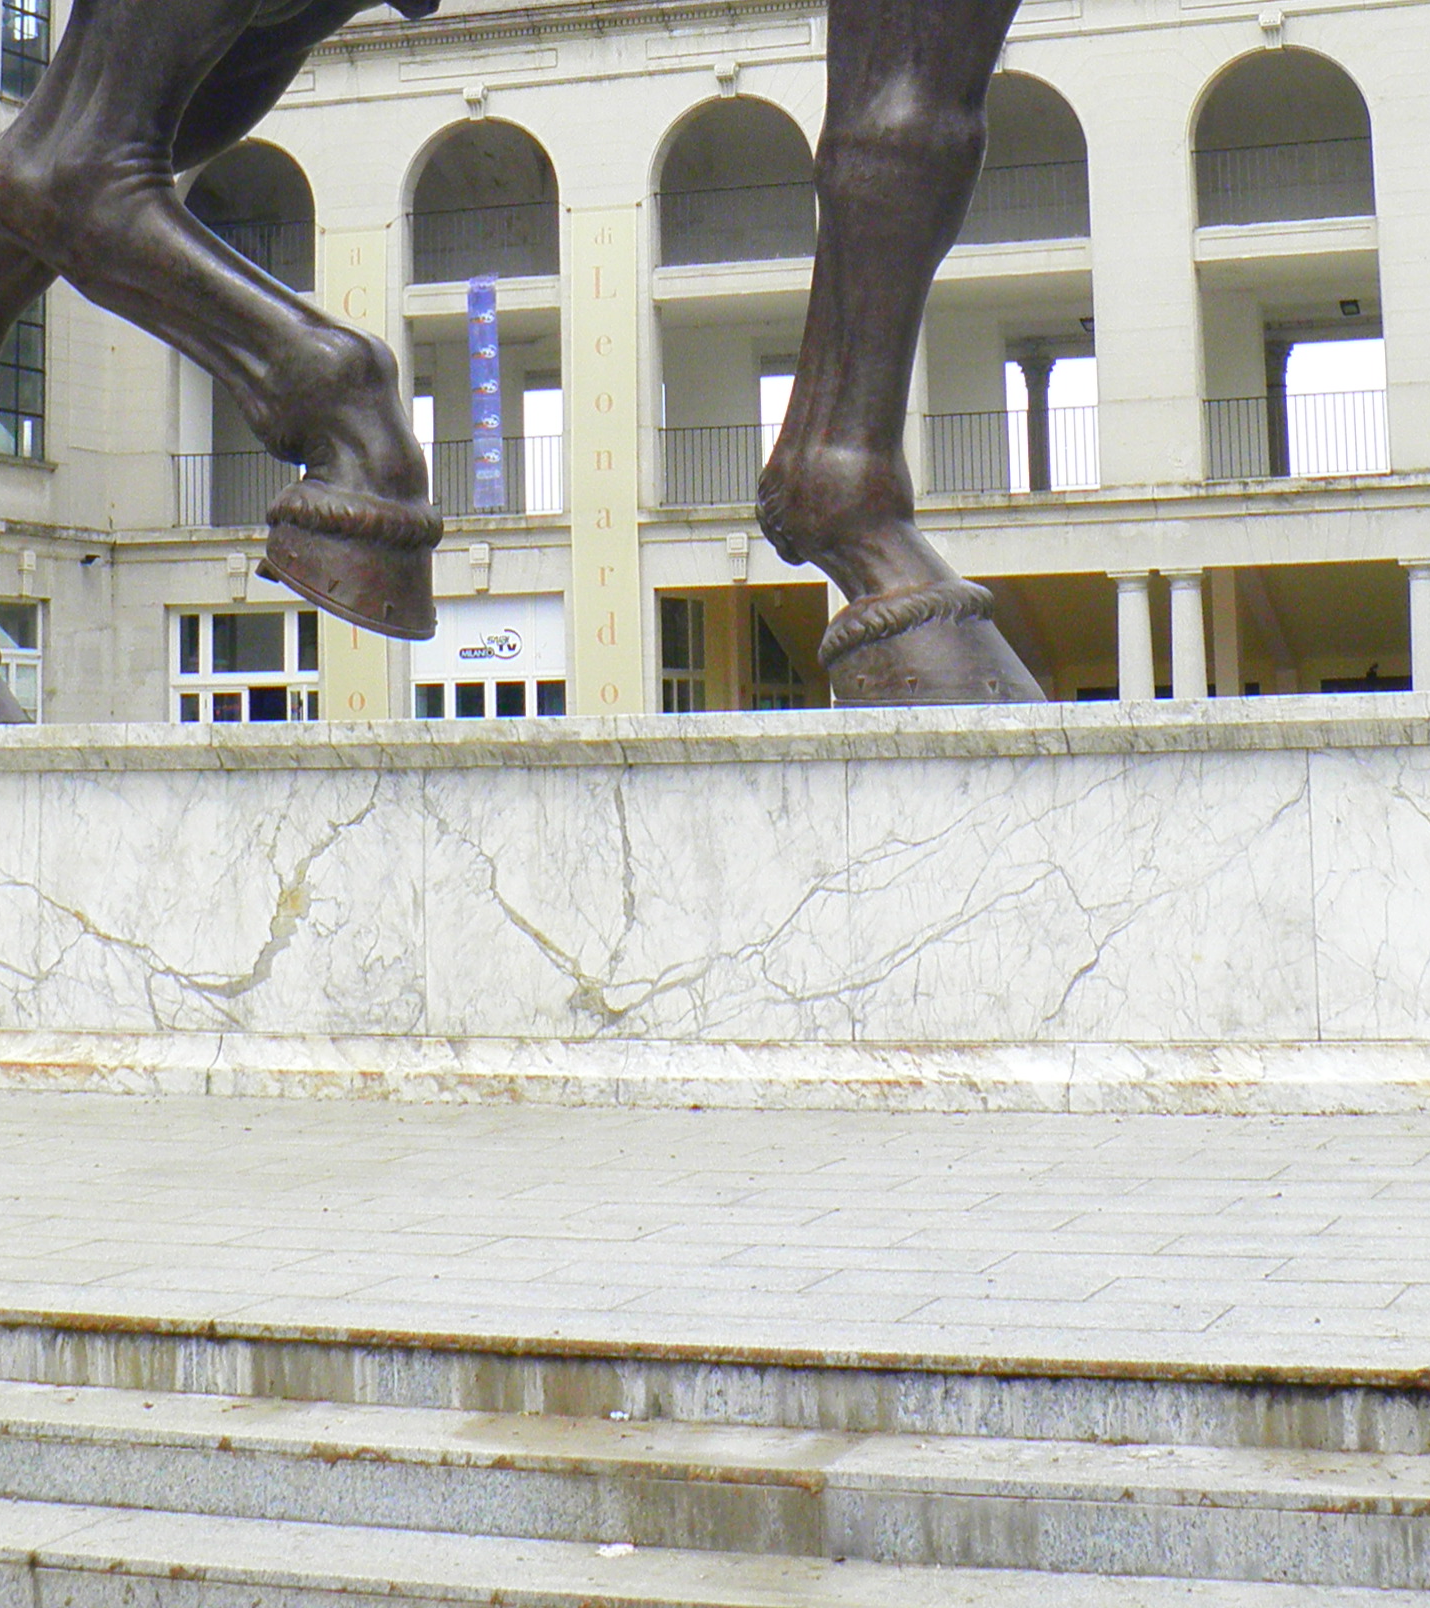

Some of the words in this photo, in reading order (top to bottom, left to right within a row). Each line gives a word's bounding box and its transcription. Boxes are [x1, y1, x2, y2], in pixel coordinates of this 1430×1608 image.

[594, 227, 614, 246] di
[592, 265, 619, 706] Leonardo
[498, 643, 517, 652] TV
